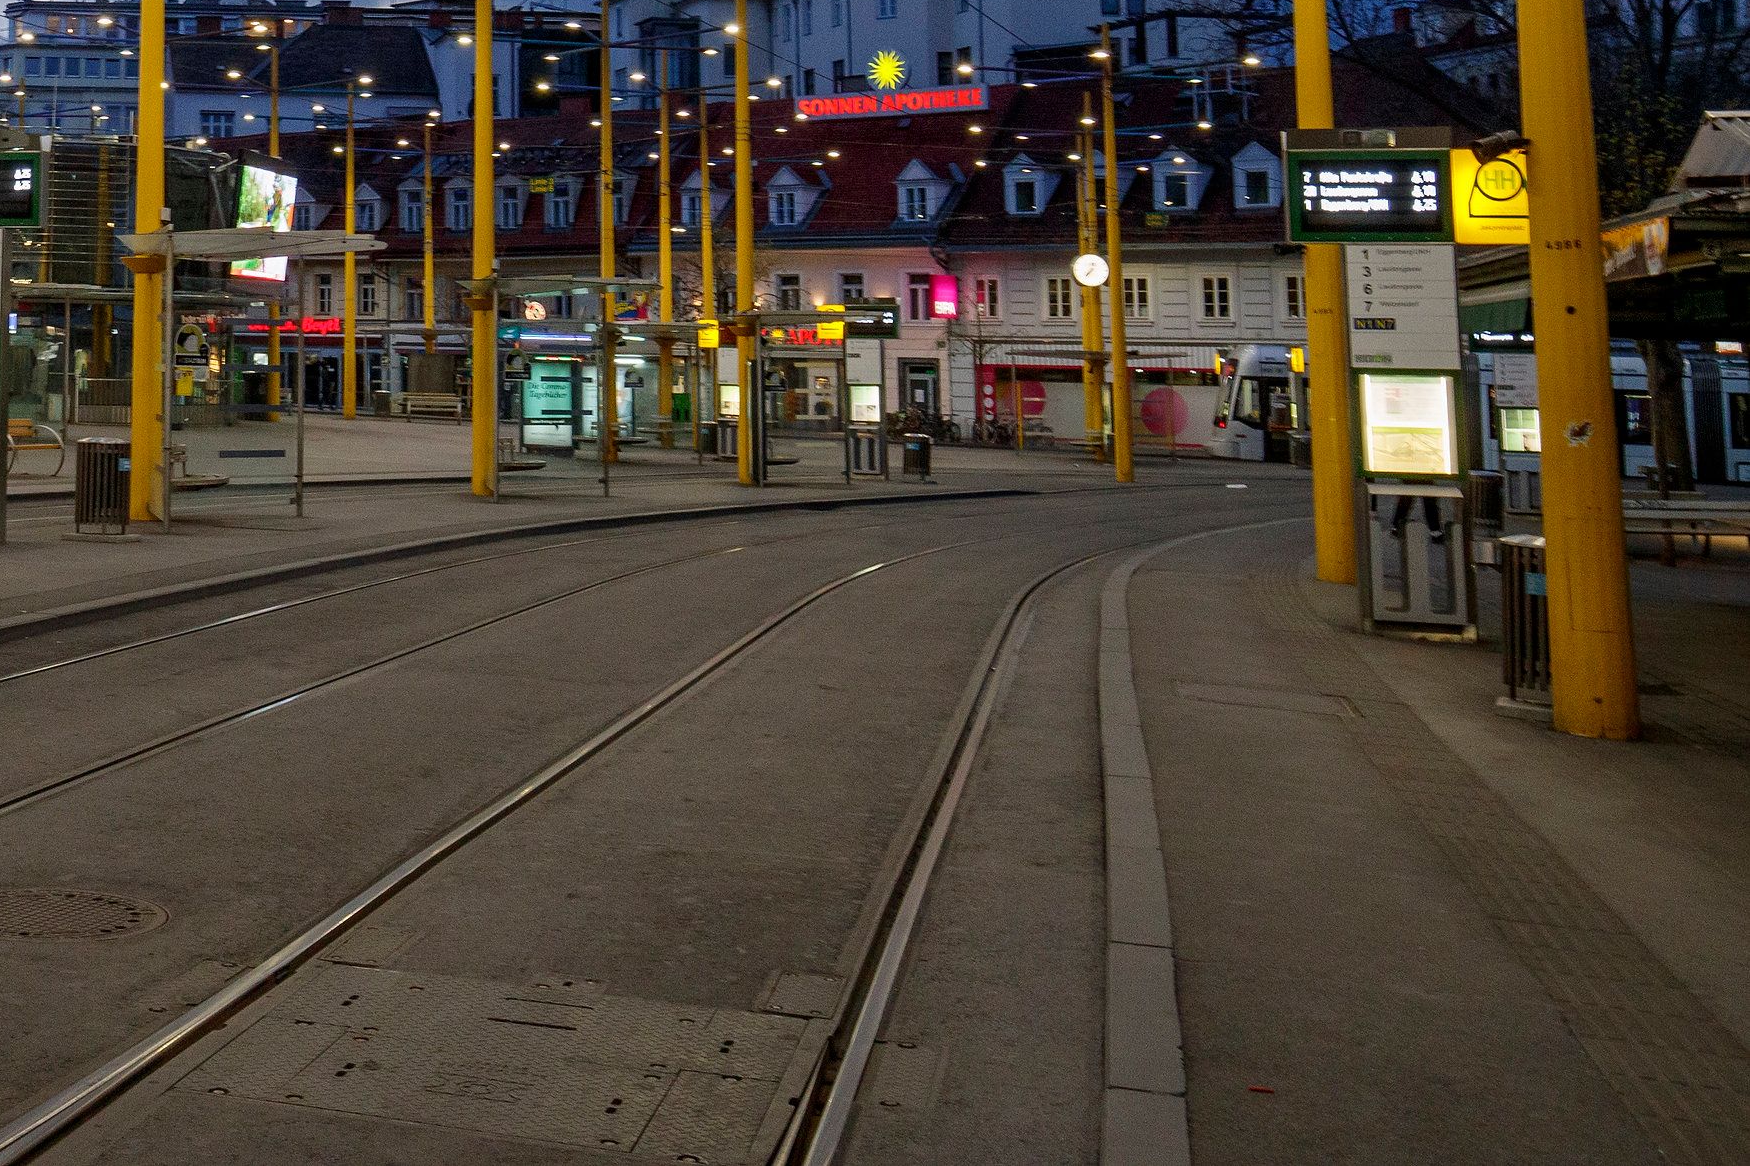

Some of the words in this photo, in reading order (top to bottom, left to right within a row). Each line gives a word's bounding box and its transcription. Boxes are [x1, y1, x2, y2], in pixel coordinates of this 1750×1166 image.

[797, 95, 877, 117] SONNEN
[880, 87, 983, 112] APOTHEKE
[1360, 248, 1370, 261] 1
[1362, 266, 1373, 279] 3
[1363, 283, 1374, 296] 6
[1364, 300, 1373, 313] 7
